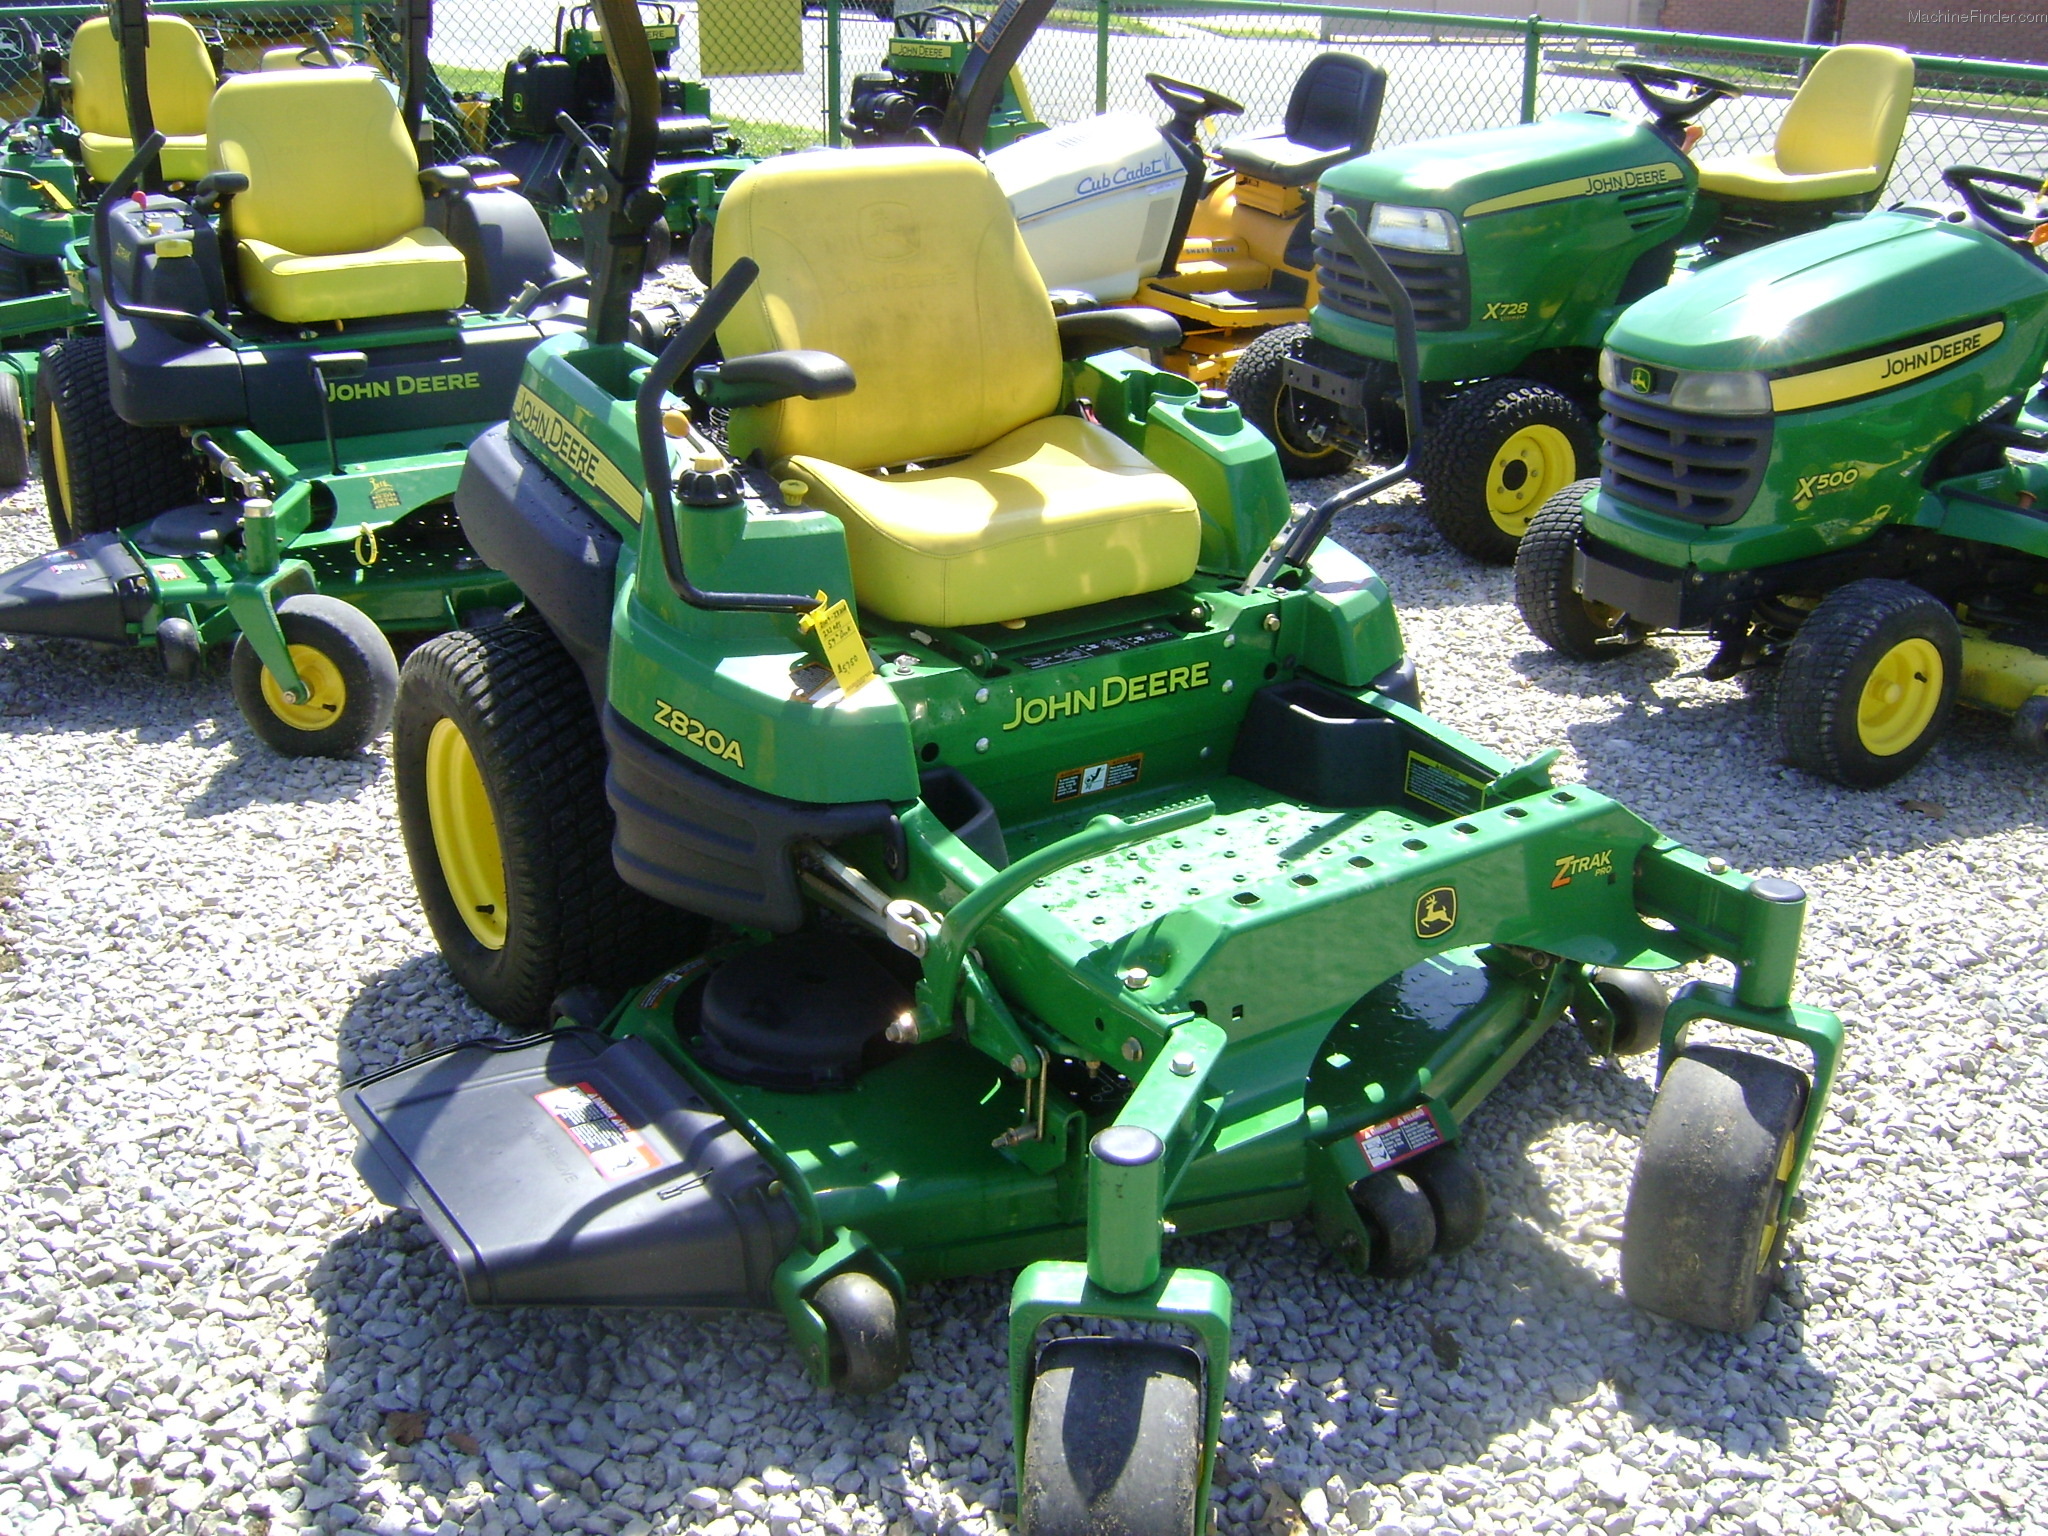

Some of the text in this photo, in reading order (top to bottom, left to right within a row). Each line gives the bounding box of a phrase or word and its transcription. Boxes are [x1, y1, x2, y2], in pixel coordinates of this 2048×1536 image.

[646, 29, 665, 38] ERE
[899, 45, 943, 57] JOHN DEERE
[1077, 159, 1162, 194] Cub Cadet
[1585, 169, 1667, 194] JOHN DEERE
[1482, 302, 1529, 320] X728
[1881, 333, 1982, 379] JOHN DEERE
[328, 372, 480, 402] JOHN DEERE
[515, 392, 599, 482] JOHN DEERE
[1791, 468, 1859, 501] X500
[1002, 661, 1210, 731] JOHN DEERE
[654, 699, 744, 768] Z820A
[1595, 865, 1612, 876] PRO
